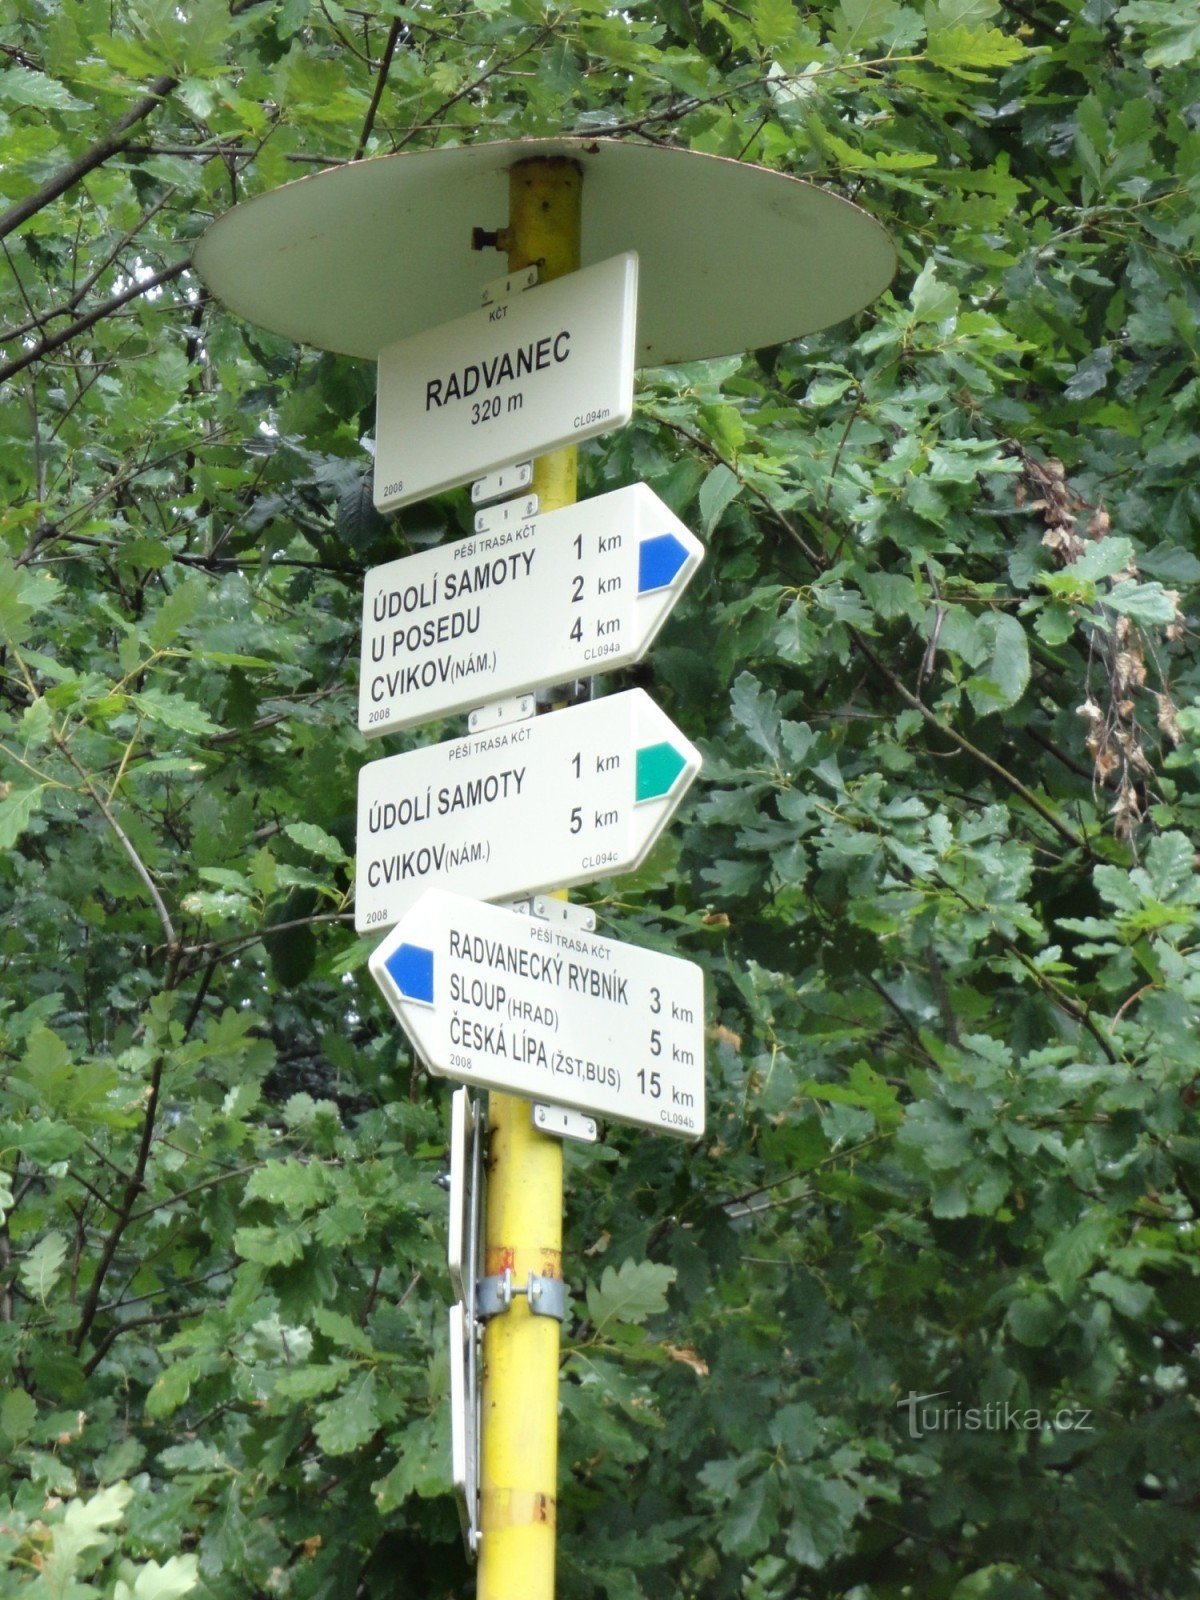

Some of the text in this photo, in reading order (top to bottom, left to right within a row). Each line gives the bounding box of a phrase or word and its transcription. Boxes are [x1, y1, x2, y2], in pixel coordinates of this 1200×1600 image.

[489, 305, 508, 322] KČT
[426, 331, 571, 411] RADVANEC
[471, 393, 523, 425] 320 m
[573, 408, 610, 427] CL094m
[383, 481, 403, 497] 2008
[454, 524, 536, 560] PĚŠÍ TRASA KČT
[374, 534, 622, 622] ÚDOLÍ SAMOTY 1 km
[372, 575, 621, 662] U POSEDU 2 km
[569, 617, 582, 643] 4
[597, 617, 620, 637] km
[584, 643, 620, 660] CL094a
[369, 708, 390, 723] 2008
[449, 728, 532, 761] PĚŠÍ TRASA KČT
[369, 752, 620, 833] ÚDOLÍ SAMOTY 1 km
[570, 807, 582, 834] 5
[595, 809, 618, 828] km
[582, 852, 618, 869] CL094c
[366, 909, 388, 924] 2008
[531, 928, 611, 960] PĚŠÍ TRASA KČT
[450, 930, 693, 1024] RADVANECKÝ RYBNÍK 3 km
[450, 1011, 507, 1057] ČESKÁ
[637, 1068, 661, 1098] 15
[672, 1086, 694, 1107] km
[450, 1054, 472, 1069] 2008
[650, 1029, 661, 1056] 5
[672, 1044, 694, 1065] km
[660, 1109, 694, 1128] CL094b
